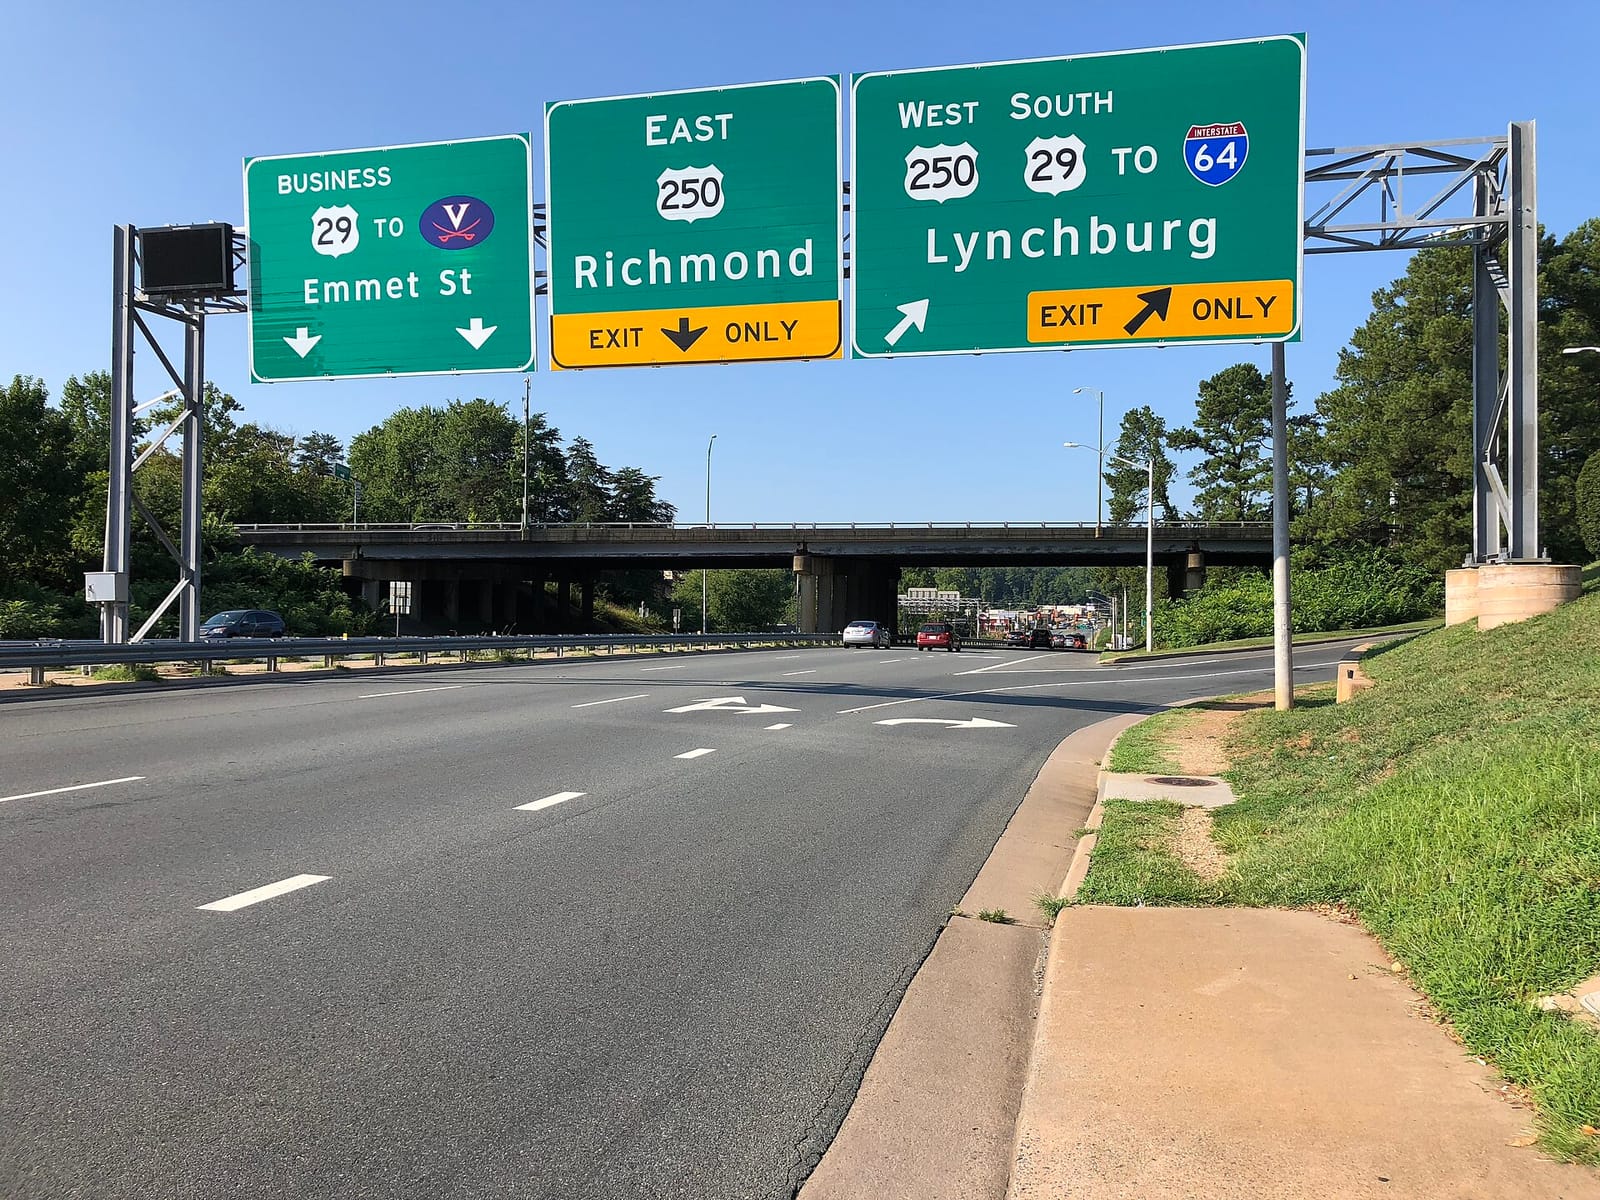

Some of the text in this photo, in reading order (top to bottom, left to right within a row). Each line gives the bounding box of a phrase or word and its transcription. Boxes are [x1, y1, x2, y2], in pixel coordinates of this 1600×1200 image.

[898, 90, 1113, 129] WEST SOUTH
[645, 113, 734, 146] EAST
[1193, 124, 1239, 138] INTERSTATE
[277, 166, 392, 194] BUSINESS
[909, 141, 1238, 190] 250 29 TO 64
[660, 176, 722, 210] 250
[317, 203, 471, 246] 29 TO V
[926, 215, 1217, 273] Lynchburg
[574, 238, 814, 289] Richmond
[303, 268, 472, 304] Emmet St
[1041, 295, 1278, 328] EXIT ONLY
[589, 319, 799, 349] EXIT ONLY
